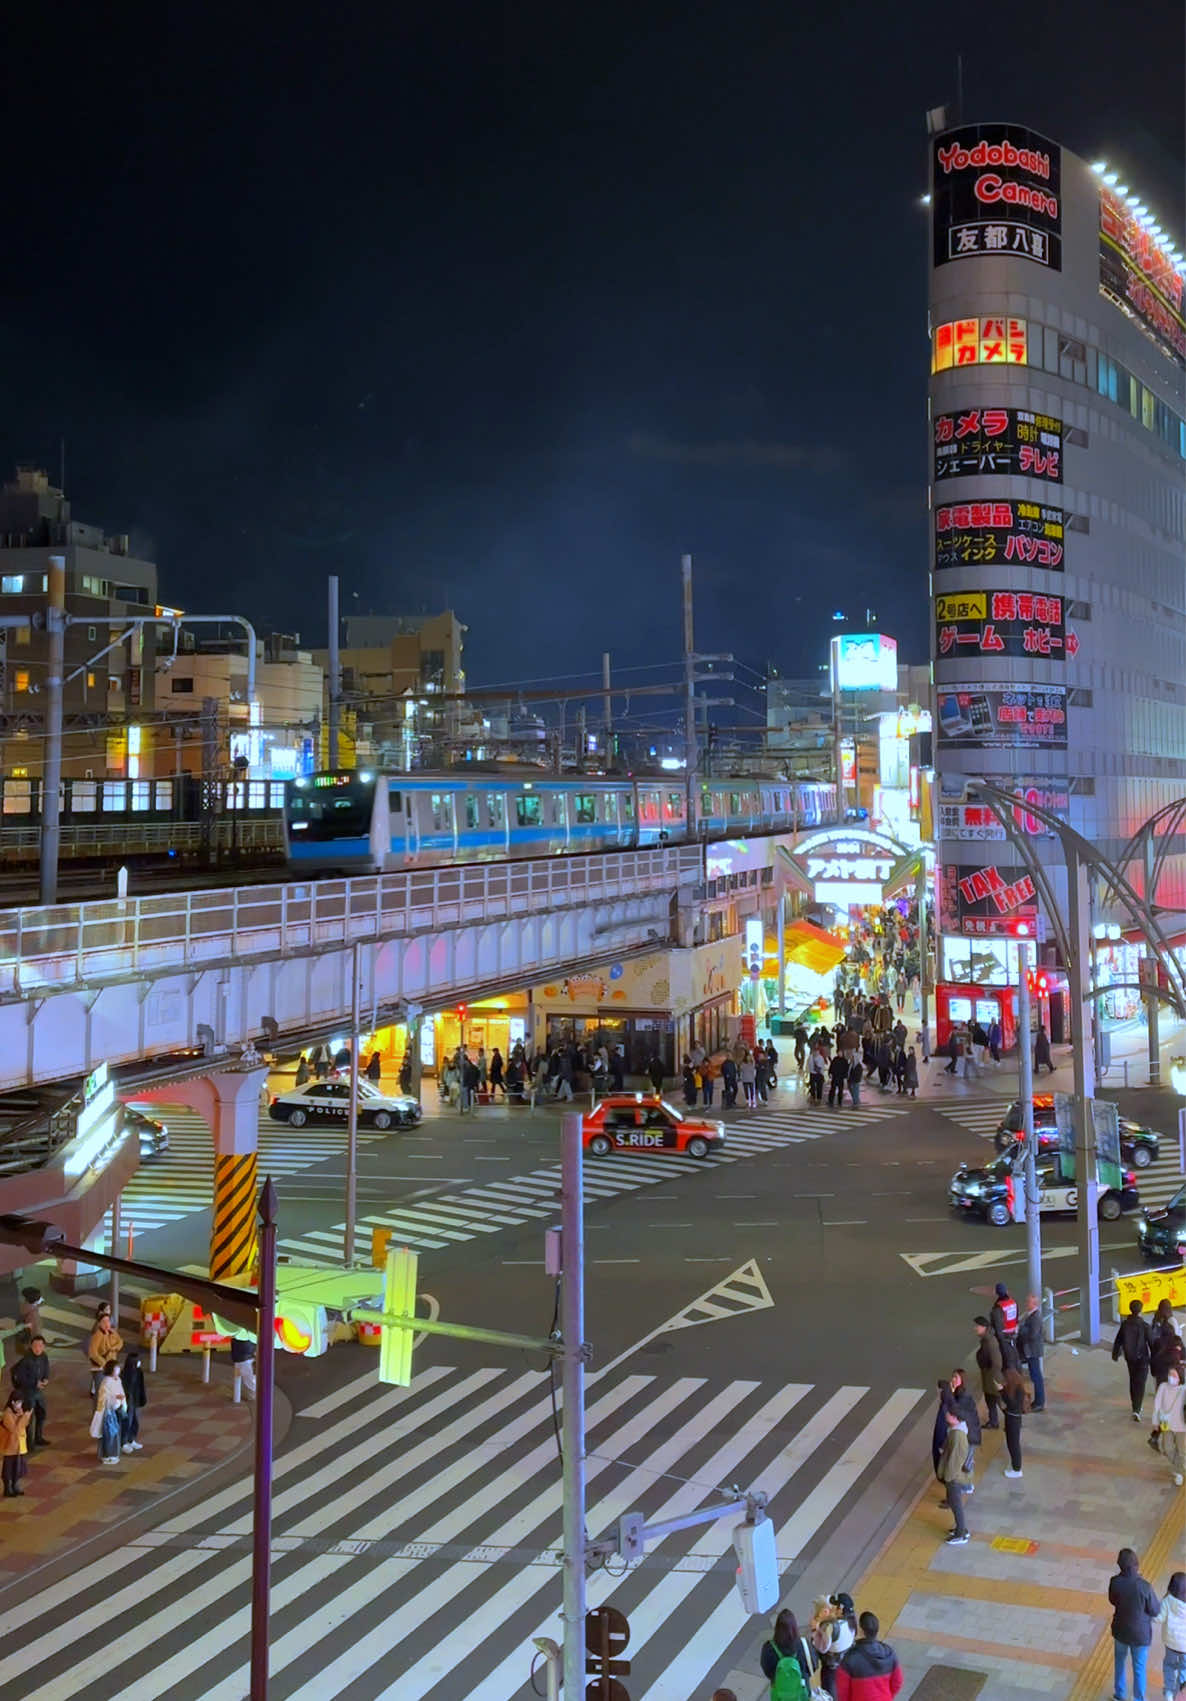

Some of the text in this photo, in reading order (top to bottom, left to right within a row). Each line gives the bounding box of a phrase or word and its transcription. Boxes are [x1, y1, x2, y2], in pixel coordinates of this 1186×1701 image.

[938, 140, 1050, 180] Yodobashi
[974, 172, 1058, 220] Camera
[956, 225, 1045, 259] 友都八喜
[957, 341, 1025, 364] カメラ
[936, 410, 1009, 442] カメラ
[961, 440, 1015, 454] ドライヤー
[1019, 444, 1060, 478] テレビ
[936, 453, 1011, 475] シェーバー
[936, 503, 1013, 532] 家電製品
[1004, 533, 1063, 567] パソコン
[937, 599, 983, 619] 2号店へ
[992, 592, 1061, 625] 携帯電話
[939, 625, 1005, 653] ゲーム
[1023, 627, 1063, 653] ホビー
[958, 865, 1008, 904] TAX
[992, 874, 1037, 914] FREE
[615, 1133, 663, 1147] S.RIDE
